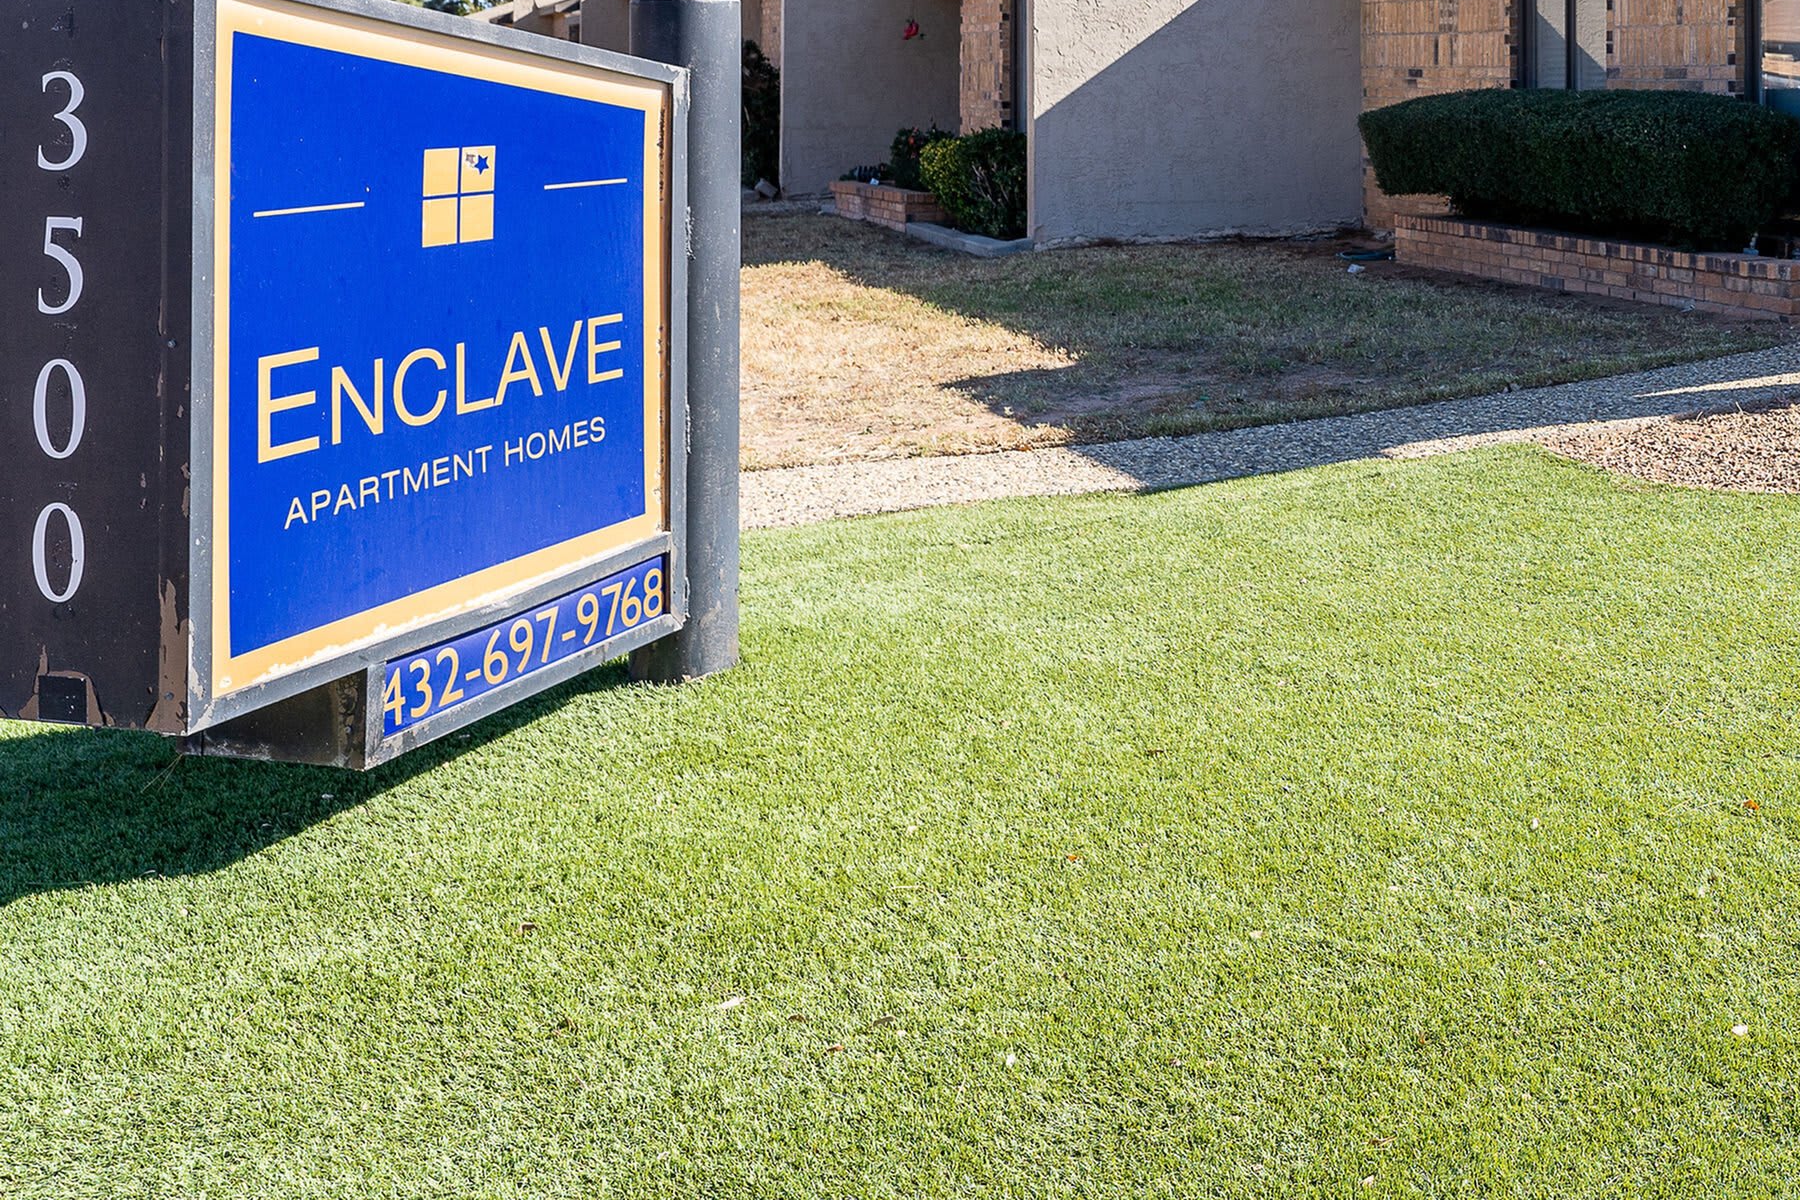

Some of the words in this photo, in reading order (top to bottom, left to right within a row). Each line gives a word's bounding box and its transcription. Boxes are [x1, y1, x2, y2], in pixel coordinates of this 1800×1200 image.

[33, 71, 87, 602] 3500
[258, 313, 624, 464] ENCLAVE
[284, 445, 493, 530] APARTMENT
[504, 416, 606, 467] HOMES
[383, 568, 663, 726] 432-697-9768
